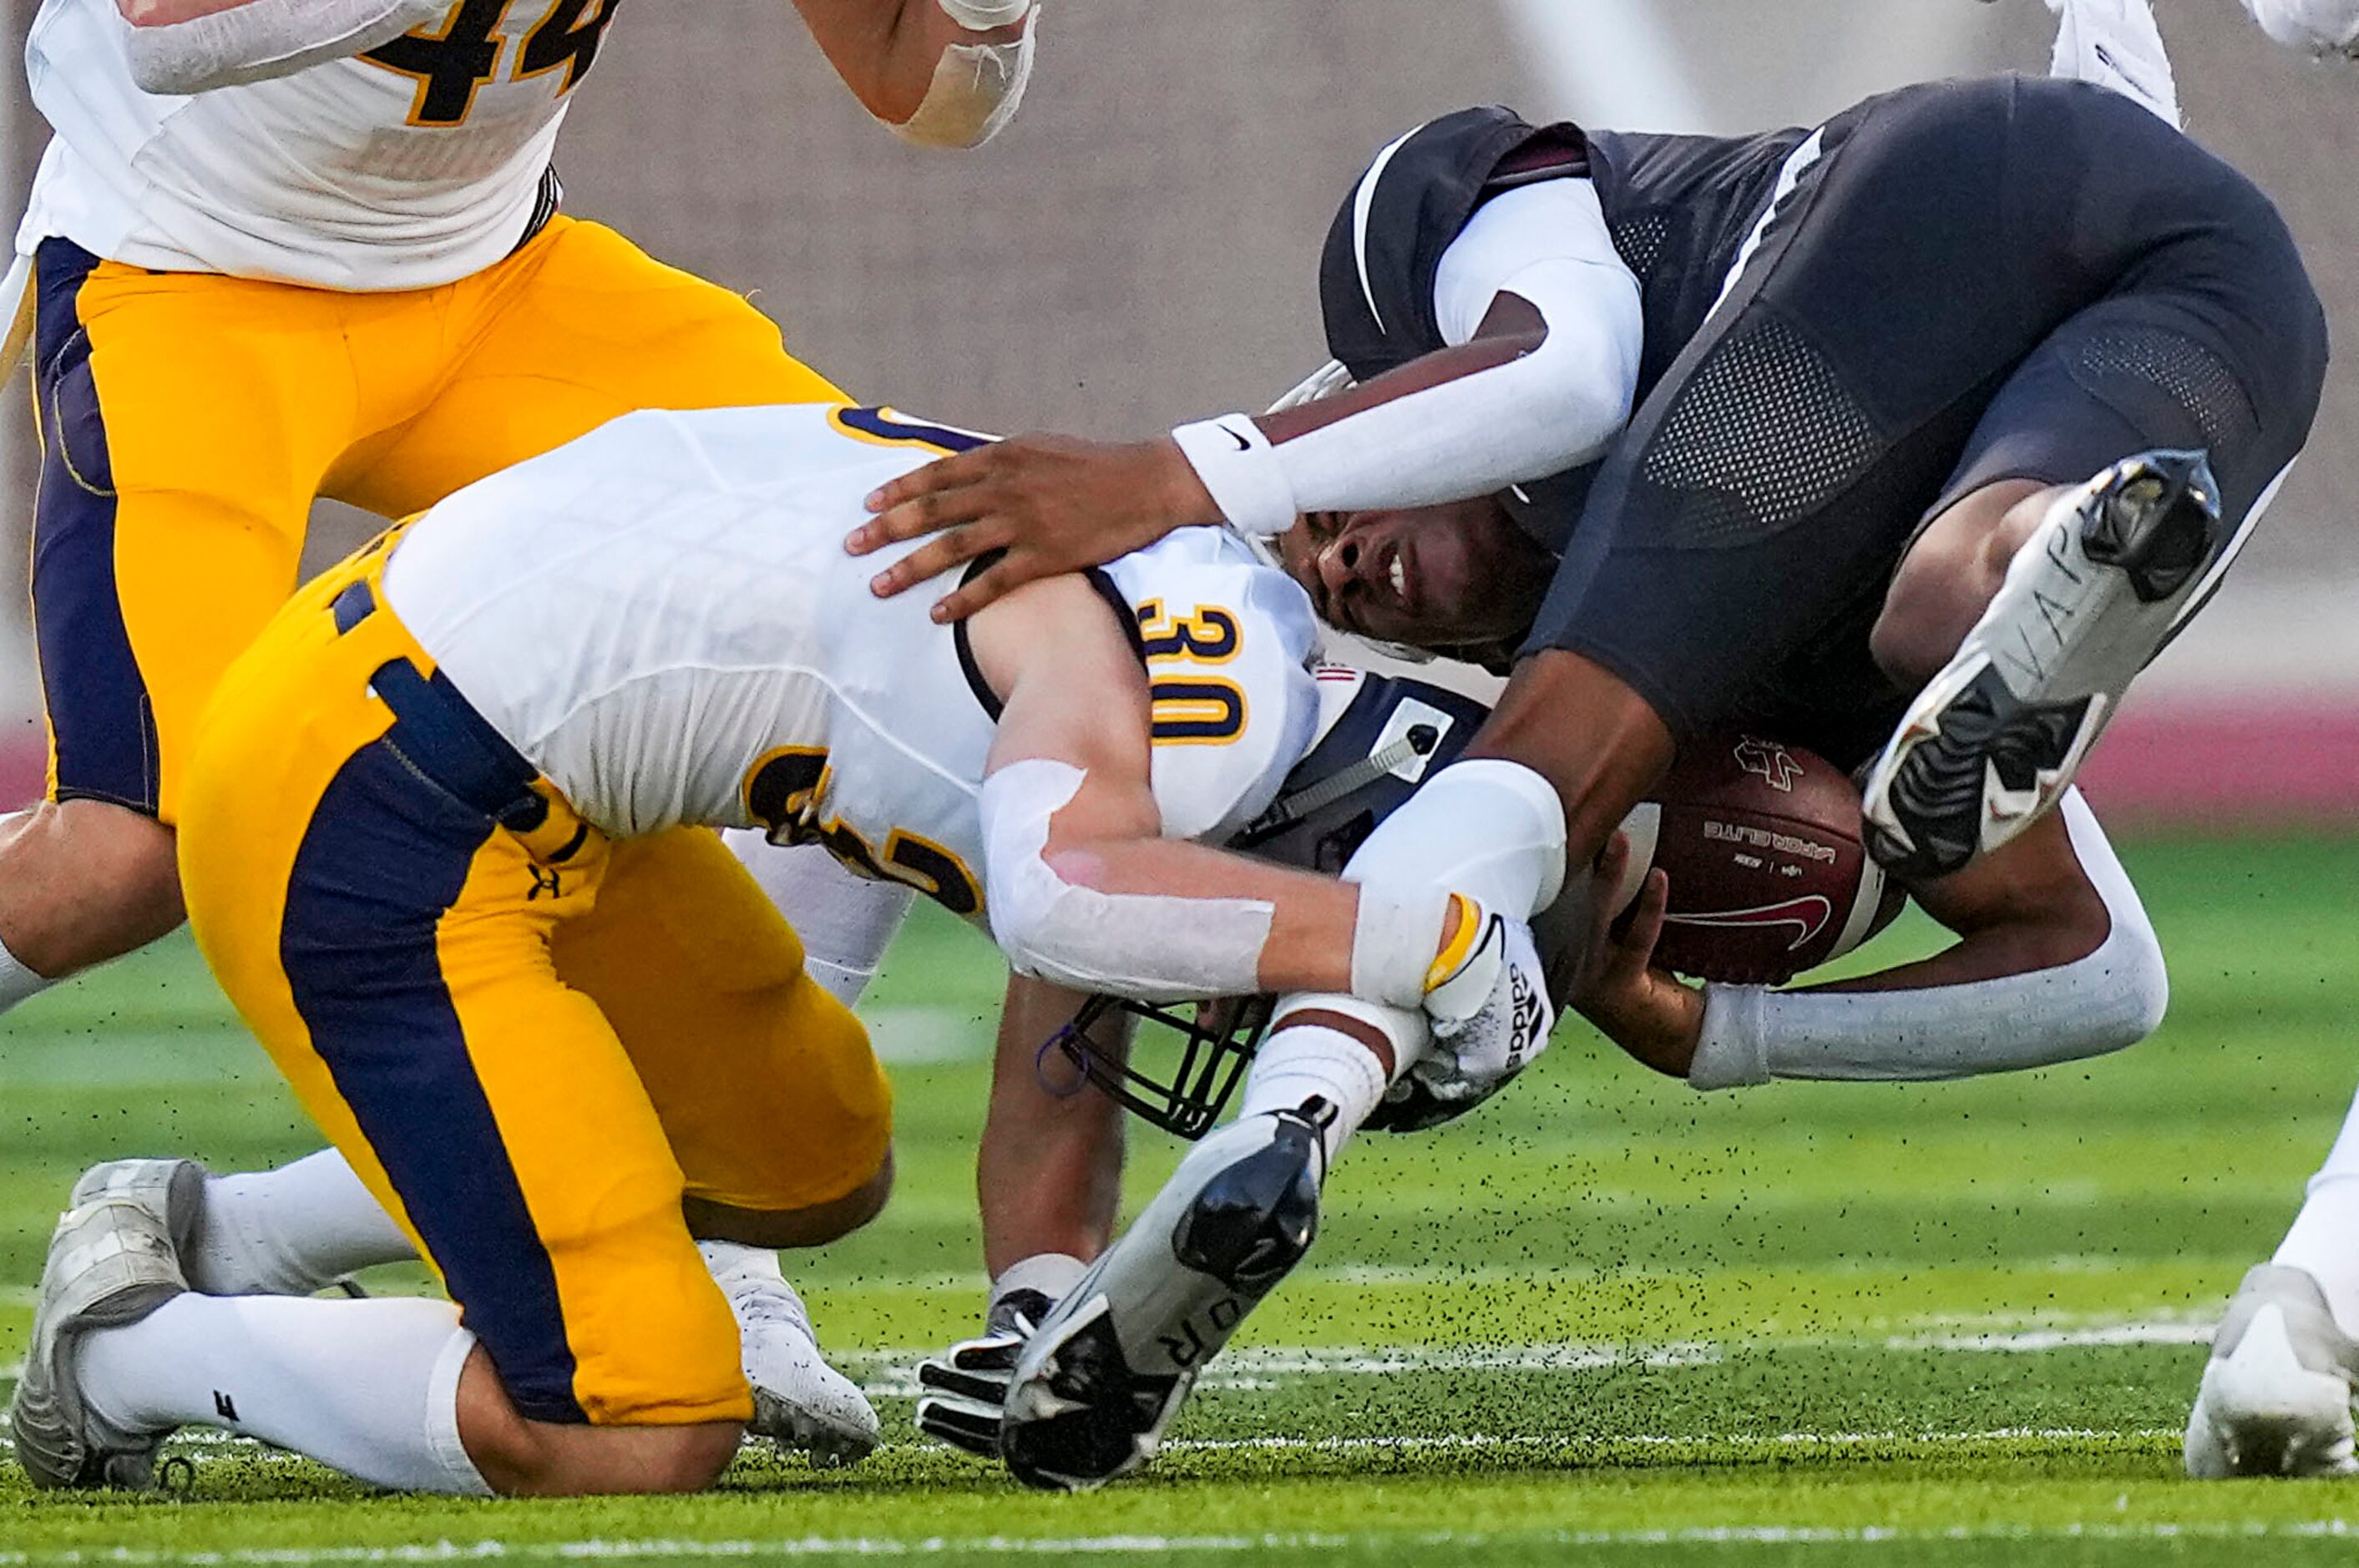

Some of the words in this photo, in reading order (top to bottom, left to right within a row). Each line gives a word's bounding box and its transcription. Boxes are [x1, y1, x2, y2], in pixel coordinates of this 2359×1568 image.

[1136, 596, 1248, 746] 30
[1703, 821, 1771, 847] ELITE
[1772, 833, 1836, 864] VAPOR
[1506, 963, 1528, 1069] adidas
